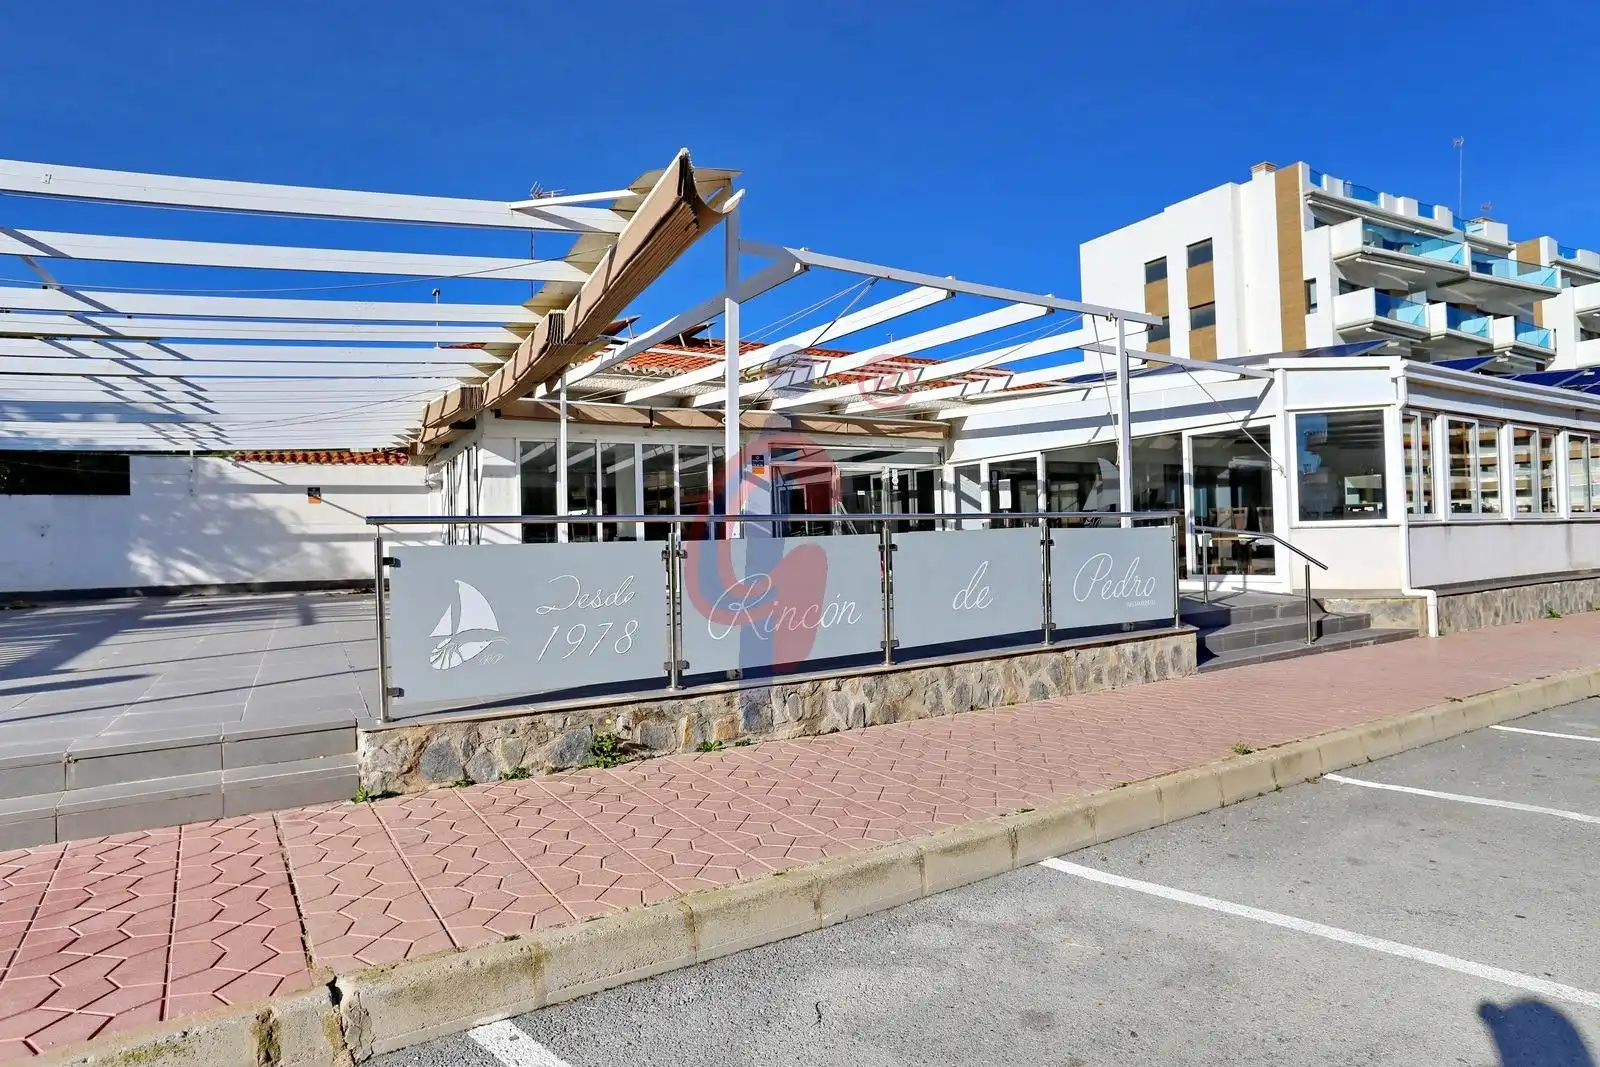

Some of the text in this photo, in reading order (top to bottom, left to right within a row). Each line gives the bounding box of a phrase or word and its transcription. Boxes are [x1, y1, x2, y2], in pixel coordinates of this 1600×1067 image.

[536, 574, 635, 615] Desde
[708, 552, 1157, 640] Rincón de Pedro
[536, 619, 639, 662] 1978
